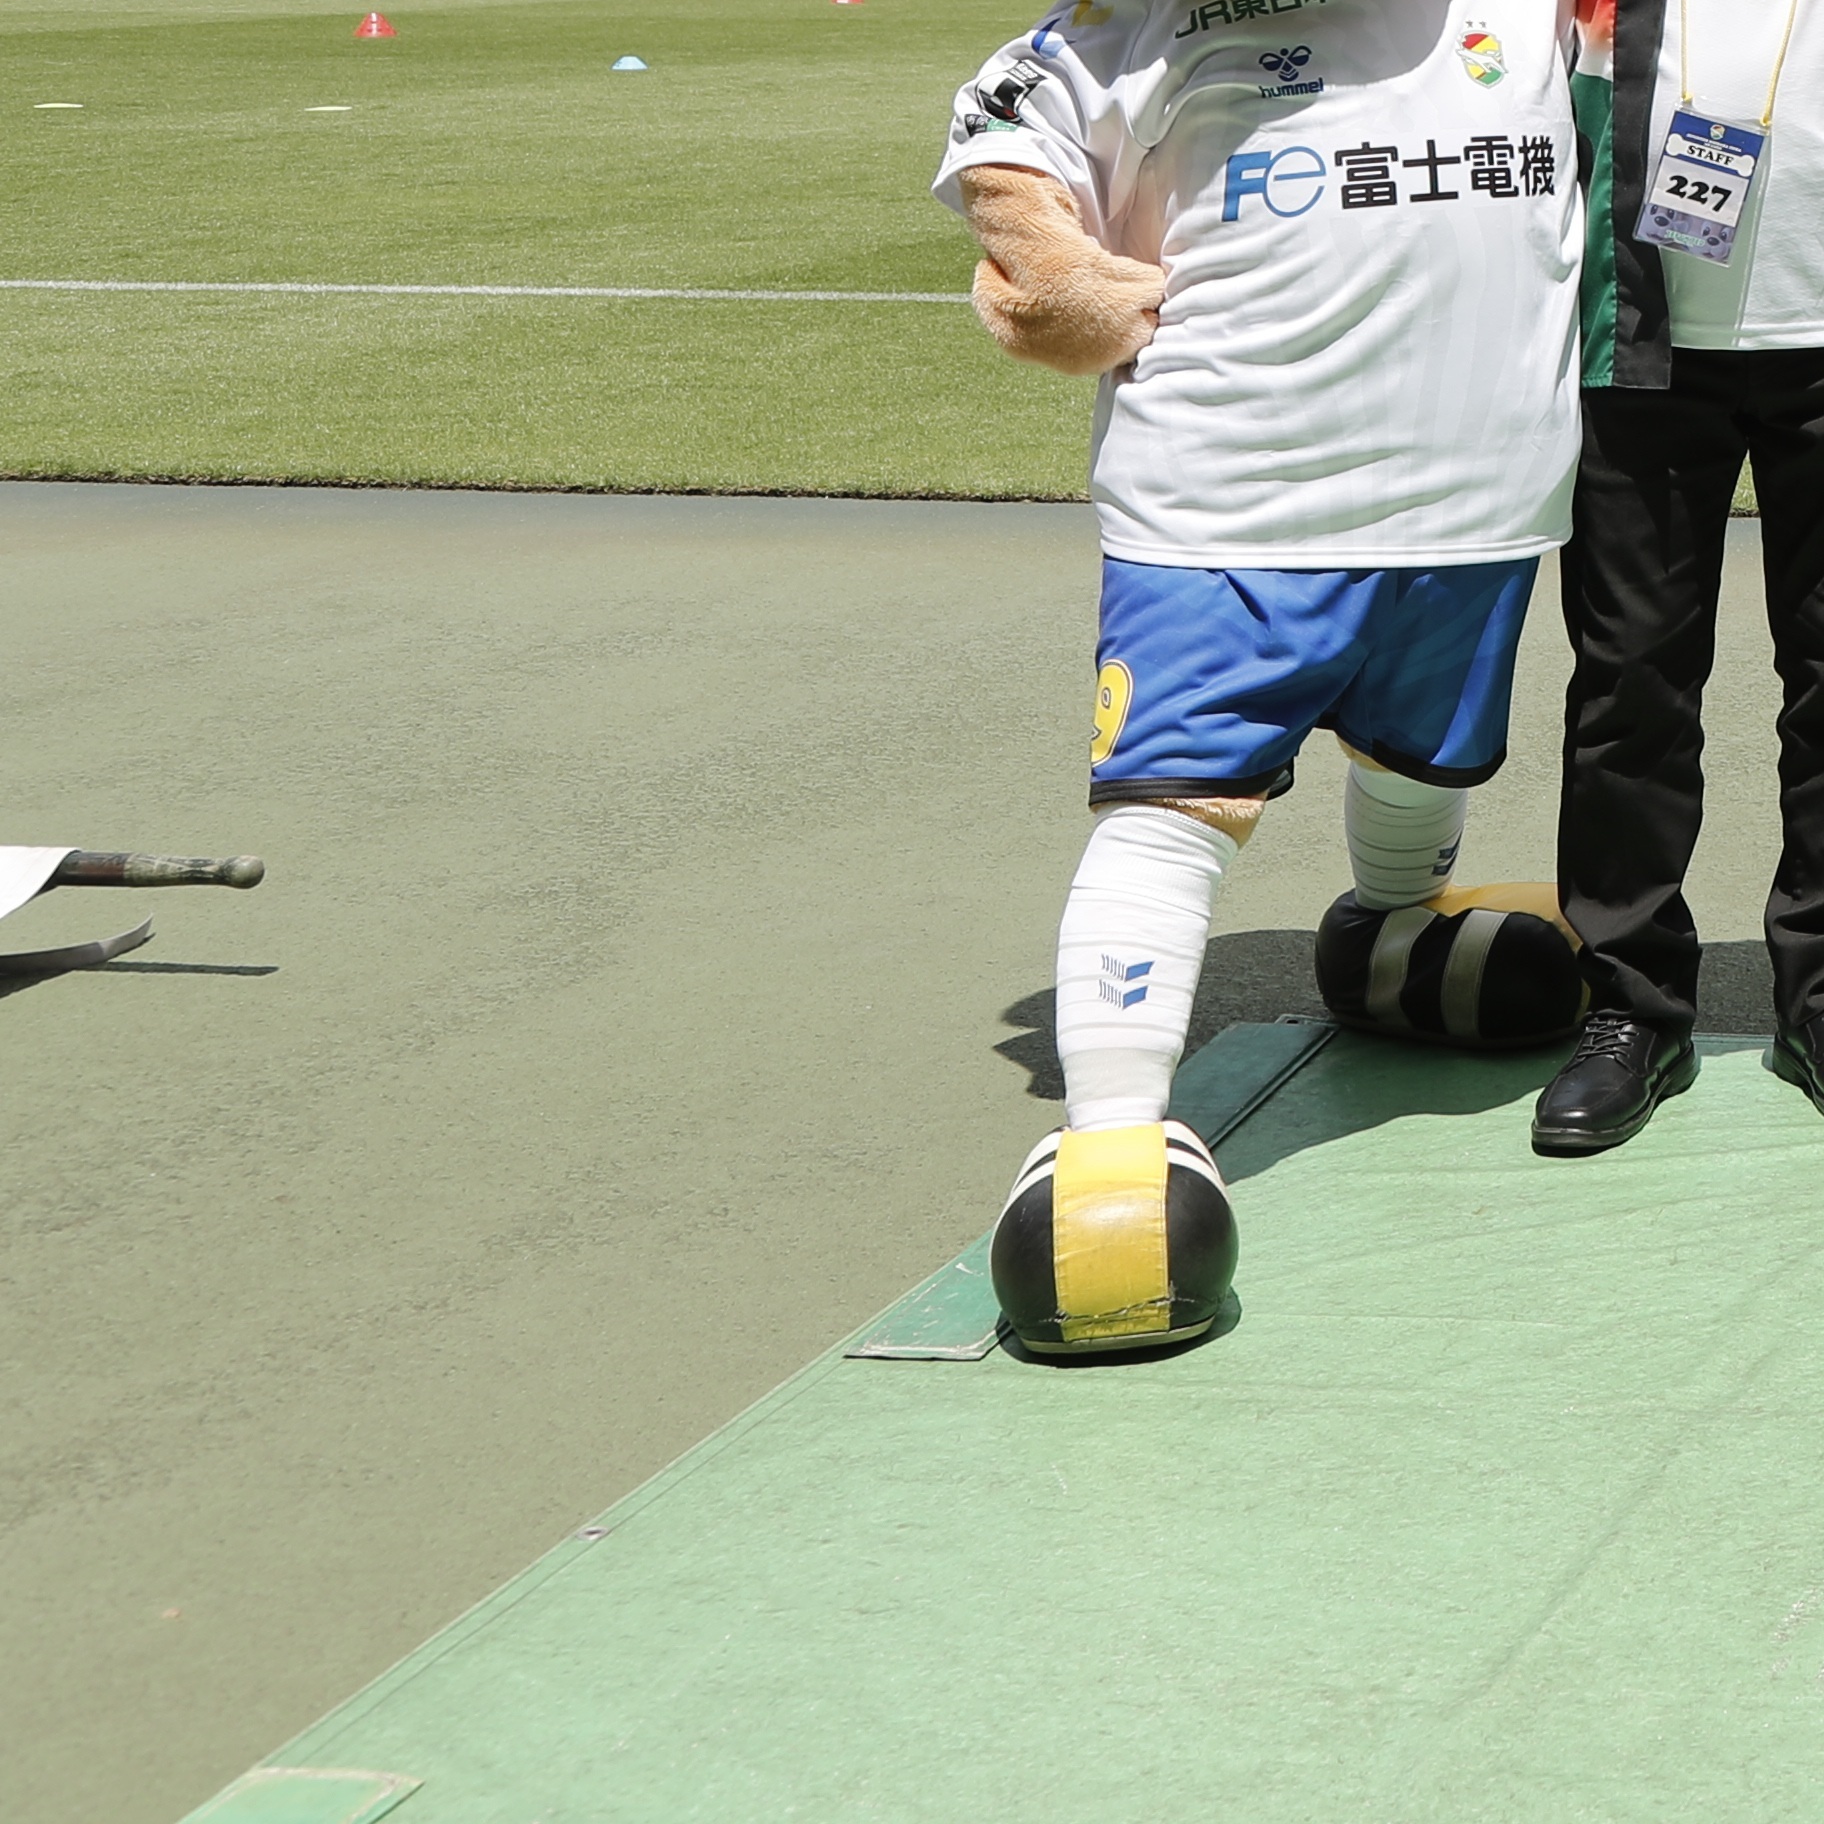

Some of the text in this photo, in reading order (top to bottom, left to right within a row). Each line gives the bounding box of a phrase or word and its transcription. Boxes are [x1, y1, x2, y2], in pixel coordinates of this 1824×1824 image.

[1258, 77, 1325, 99] hummel
[1686, 144, 1734, 166] STAFF
[1334, 134, 1557, 210] 富士電機
[1665, 174, 1733, 212] 227
